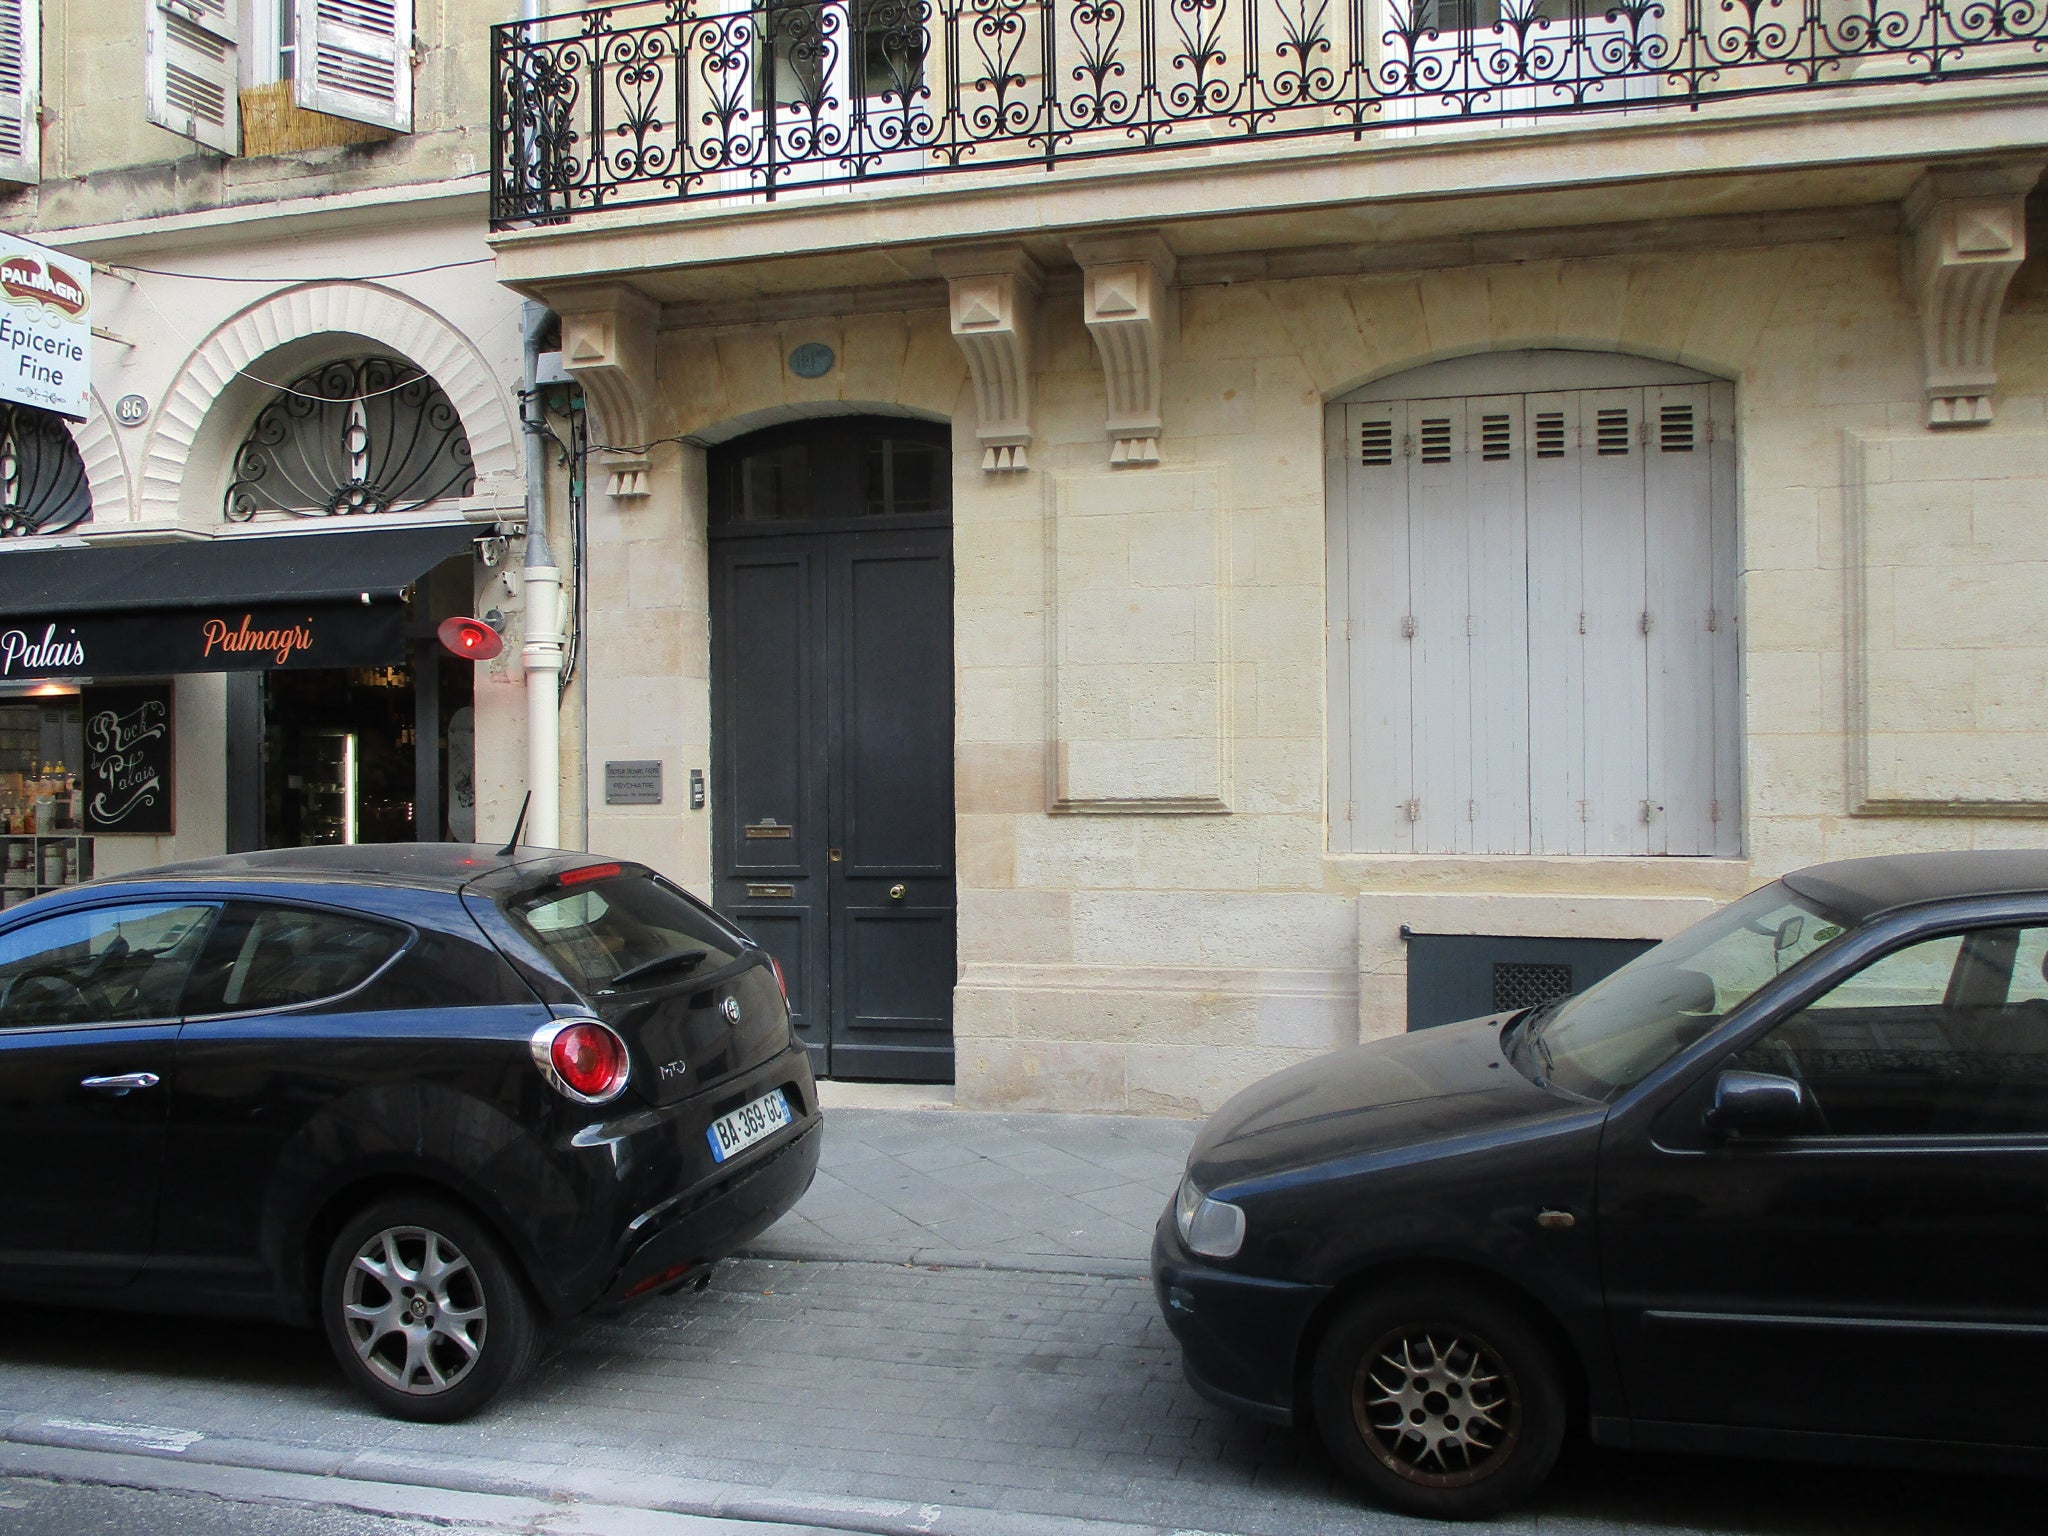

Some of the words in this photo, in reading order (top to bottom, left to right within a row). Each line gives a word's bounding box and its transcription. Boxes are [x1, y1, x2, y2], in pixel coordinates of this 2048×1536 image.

[1, 266, 82, 306] PALMAGRI
[0, 313, 83, 361] Épicerie
[19, 355, 63, 386] Fine
[122, 400, 142, 418] 86
[1, 623, 85, 675] Palais
[203, 614, 313, 665] Palmagri
[100, 752, 155, 796] Palais
